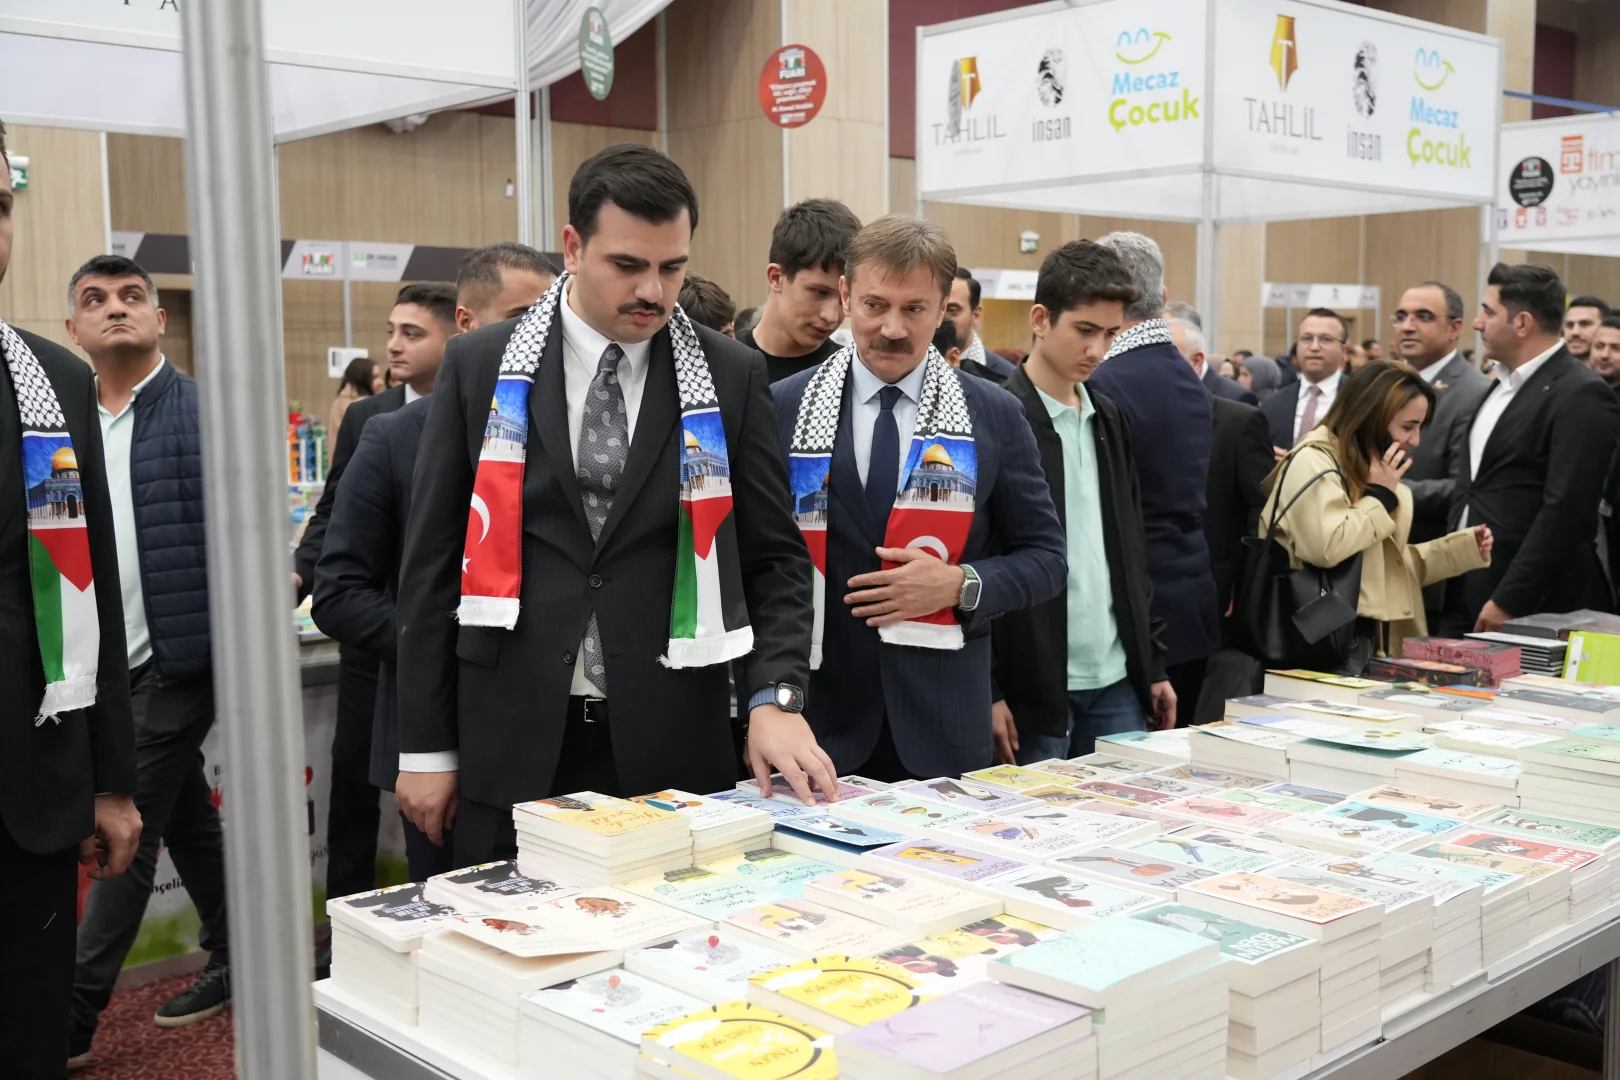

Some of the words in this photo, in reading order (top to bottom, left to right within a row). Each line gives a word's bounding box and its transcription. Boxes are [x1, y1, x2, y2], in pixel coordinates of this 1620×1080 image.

[1112, 71, 1179, 95] Mecaz
[1108, 88, 1199, 133] Çocuk
[1410, 97, 1459, 128] Mecaz
[1407, 127, 1471, 169] Çocuk
[1149, 869, 1219, 890] DAVA
[1228, 932, 1277, 948] EDEN
[1236, 934, 1302, 960] MARTIN
